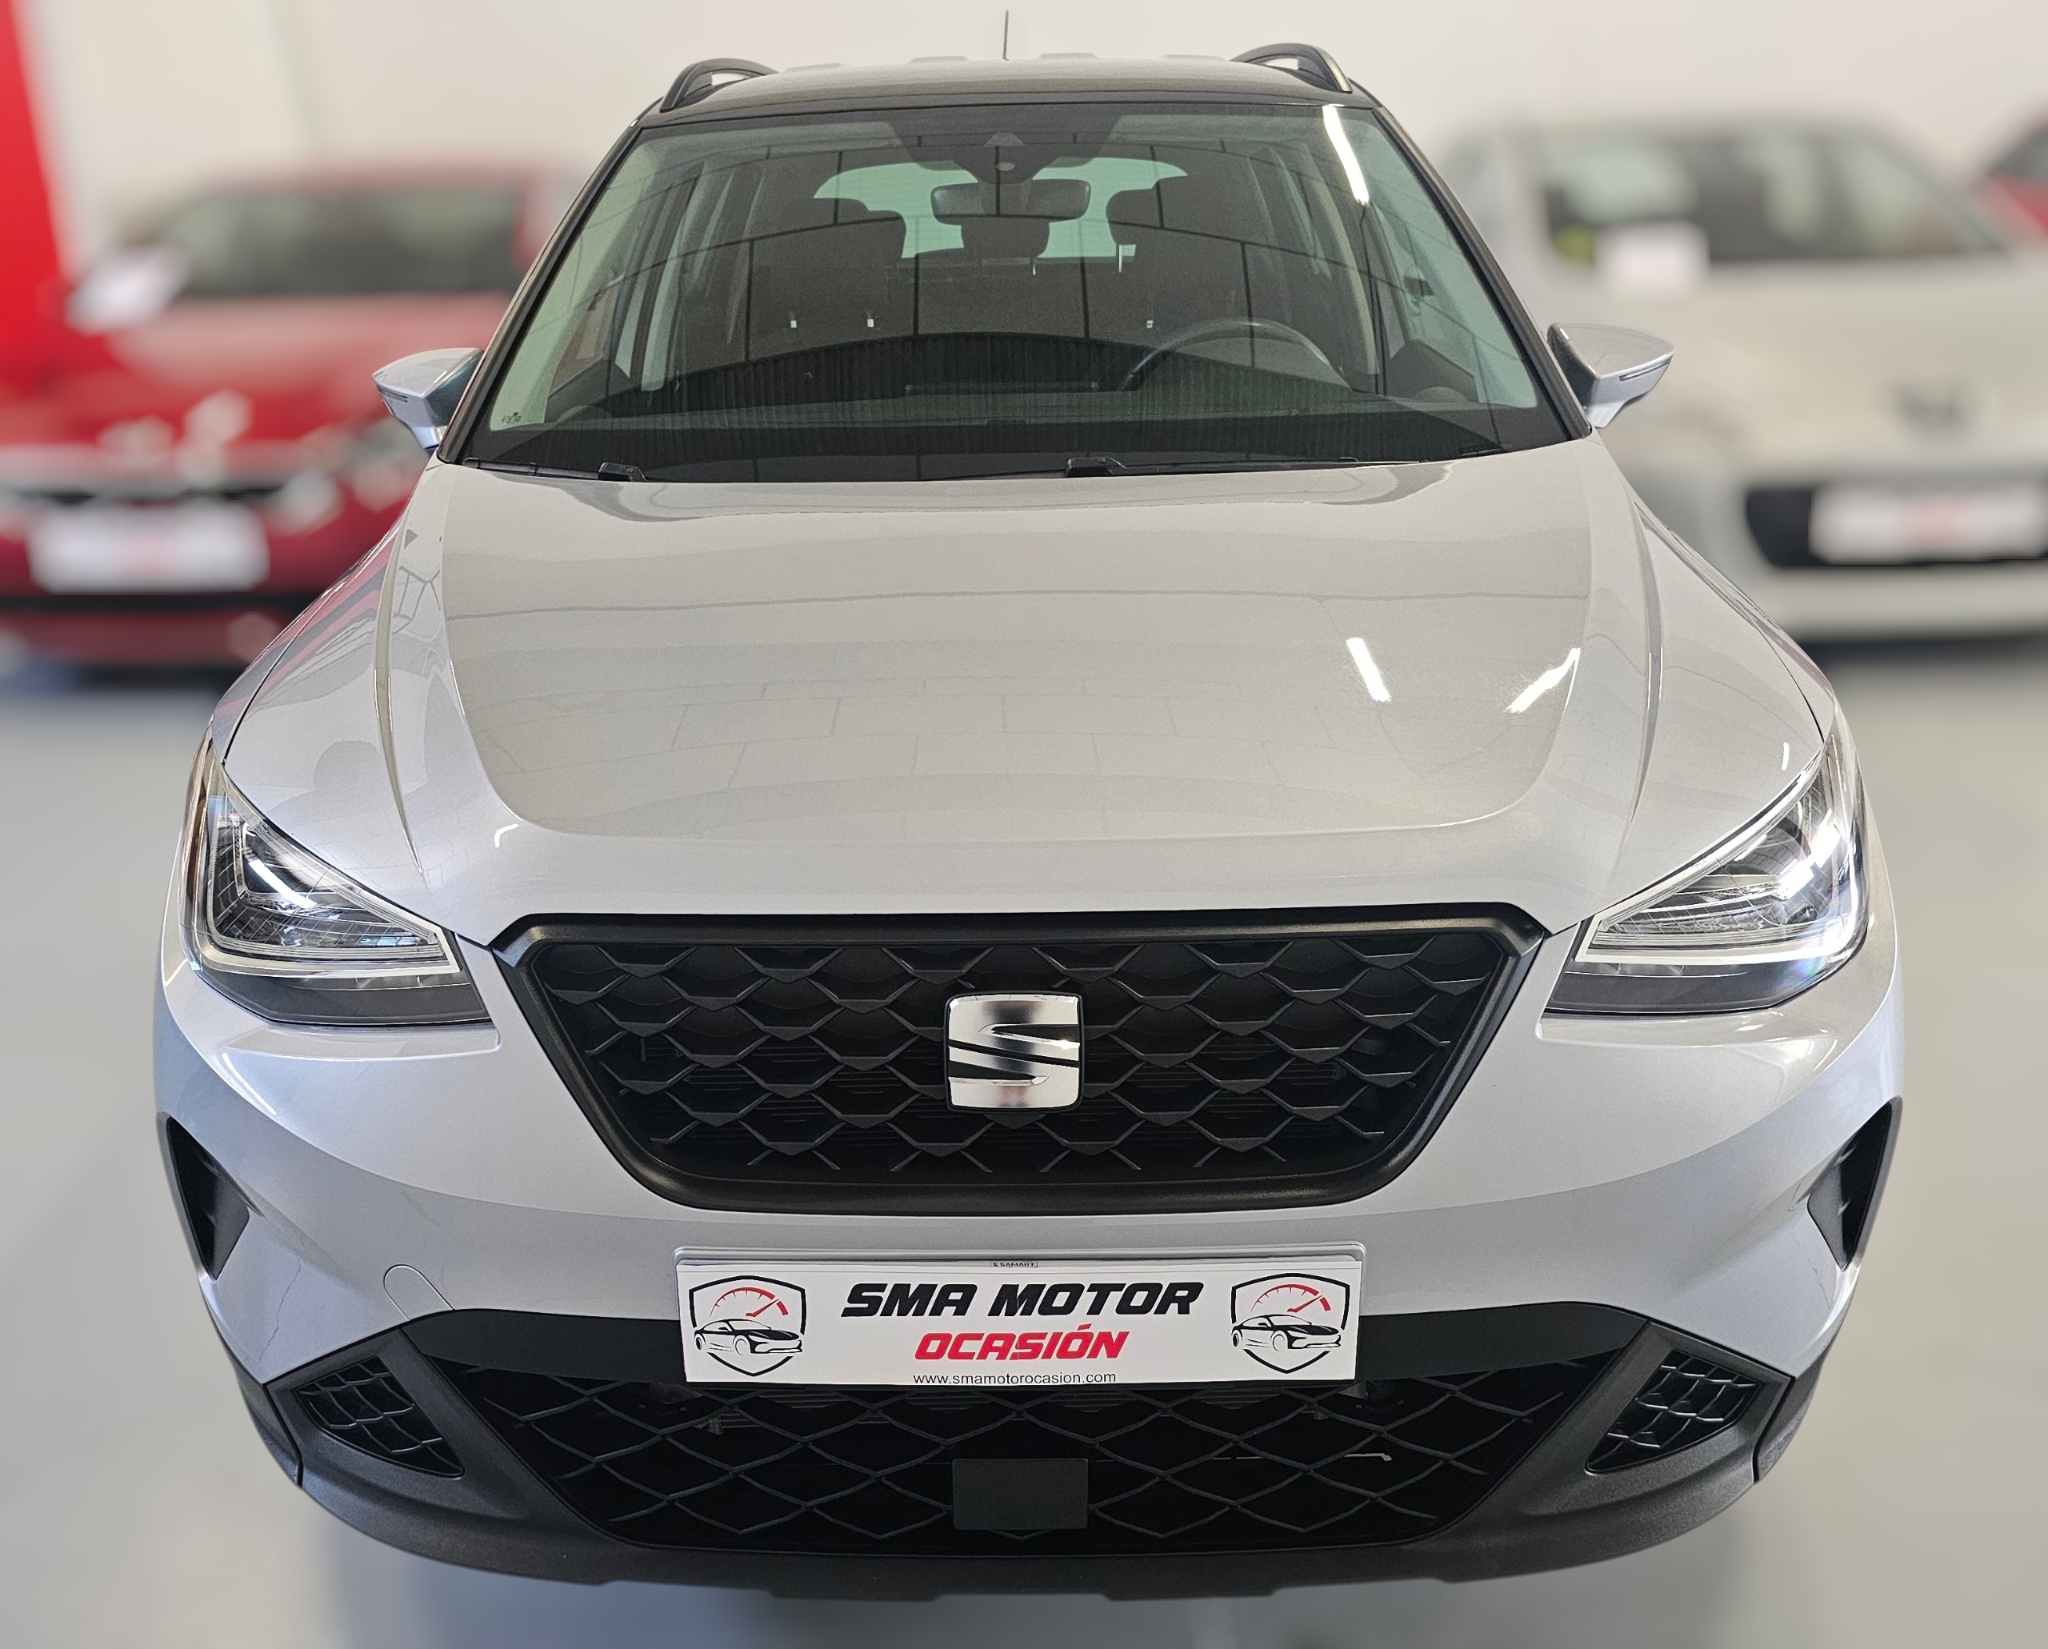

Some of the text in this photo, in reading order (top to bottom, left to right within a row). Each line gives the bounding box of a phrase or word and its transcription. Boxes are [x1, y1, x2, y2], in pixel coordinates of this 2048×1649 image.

[841, 1282, 1204, 1317] SMA MOTOR
[914, 1324, 1130, 1360] OCASIÓN
[913, 1371, 1116, 1385] www.smamotorocasion.com
